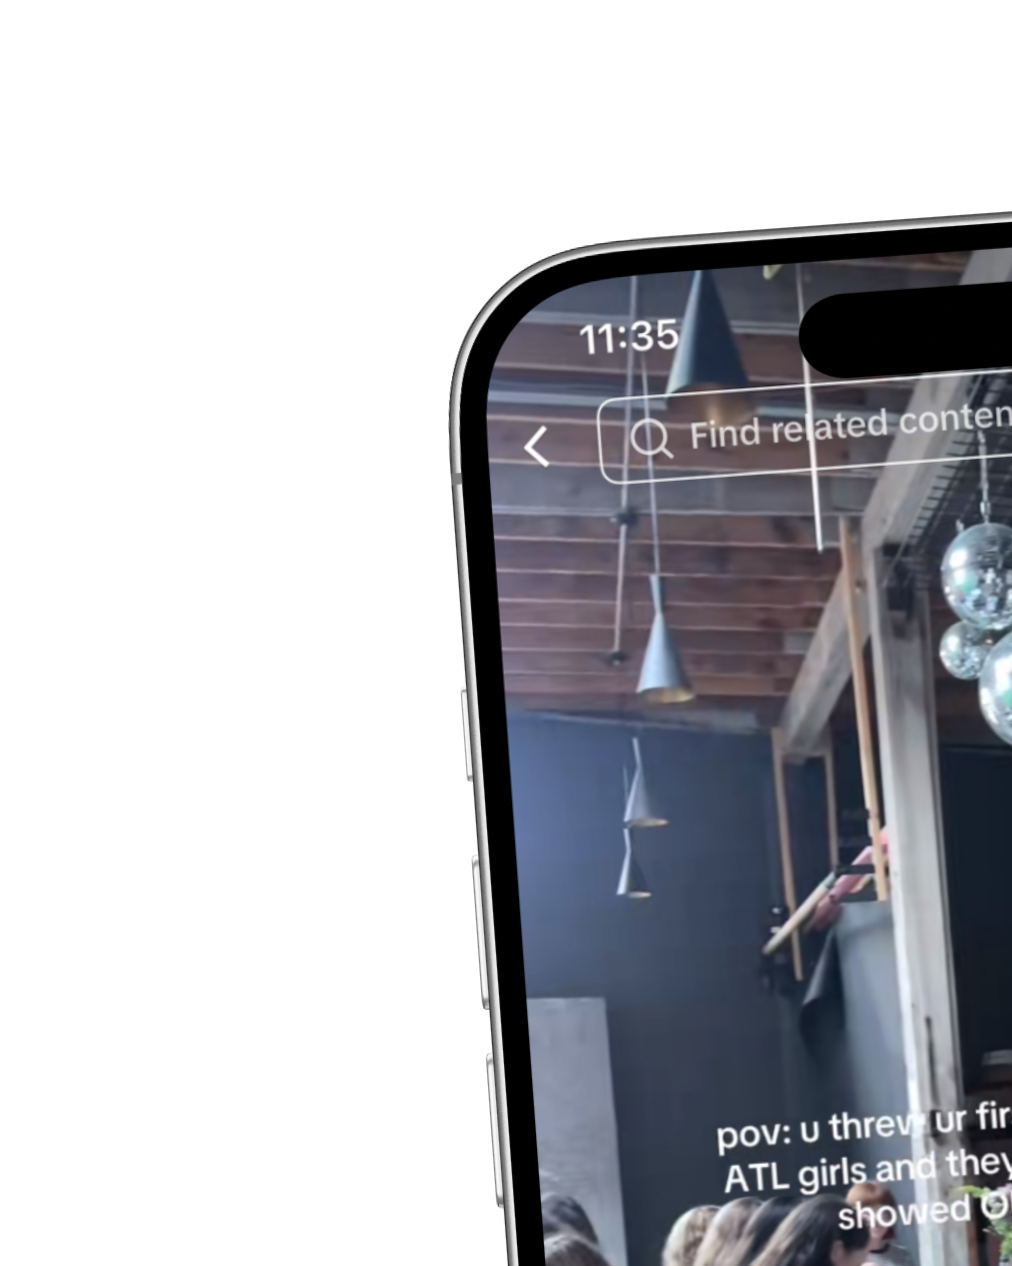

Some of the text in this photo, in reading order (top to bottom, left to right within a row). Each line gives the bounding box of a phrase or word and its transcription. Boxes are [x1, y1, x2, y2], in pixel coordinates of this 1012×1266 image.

[579, 318, 679, 355] 11:35
[690, 417, 761, 450] Find
[772, 407, 888, 444] related
[717, 1123, 791, 1156] pov:
[800, 1120, 820, 1143] u
[828, 1111, 926, 1141] threw
[935, 1109, 967, 1134] ur
[724, 1161, 790, 1193] ATL
[798, 1156, 867, 1196] girls
[876, 1151, 936, 1183] and
[838, 1193, 971, 1231] showed
